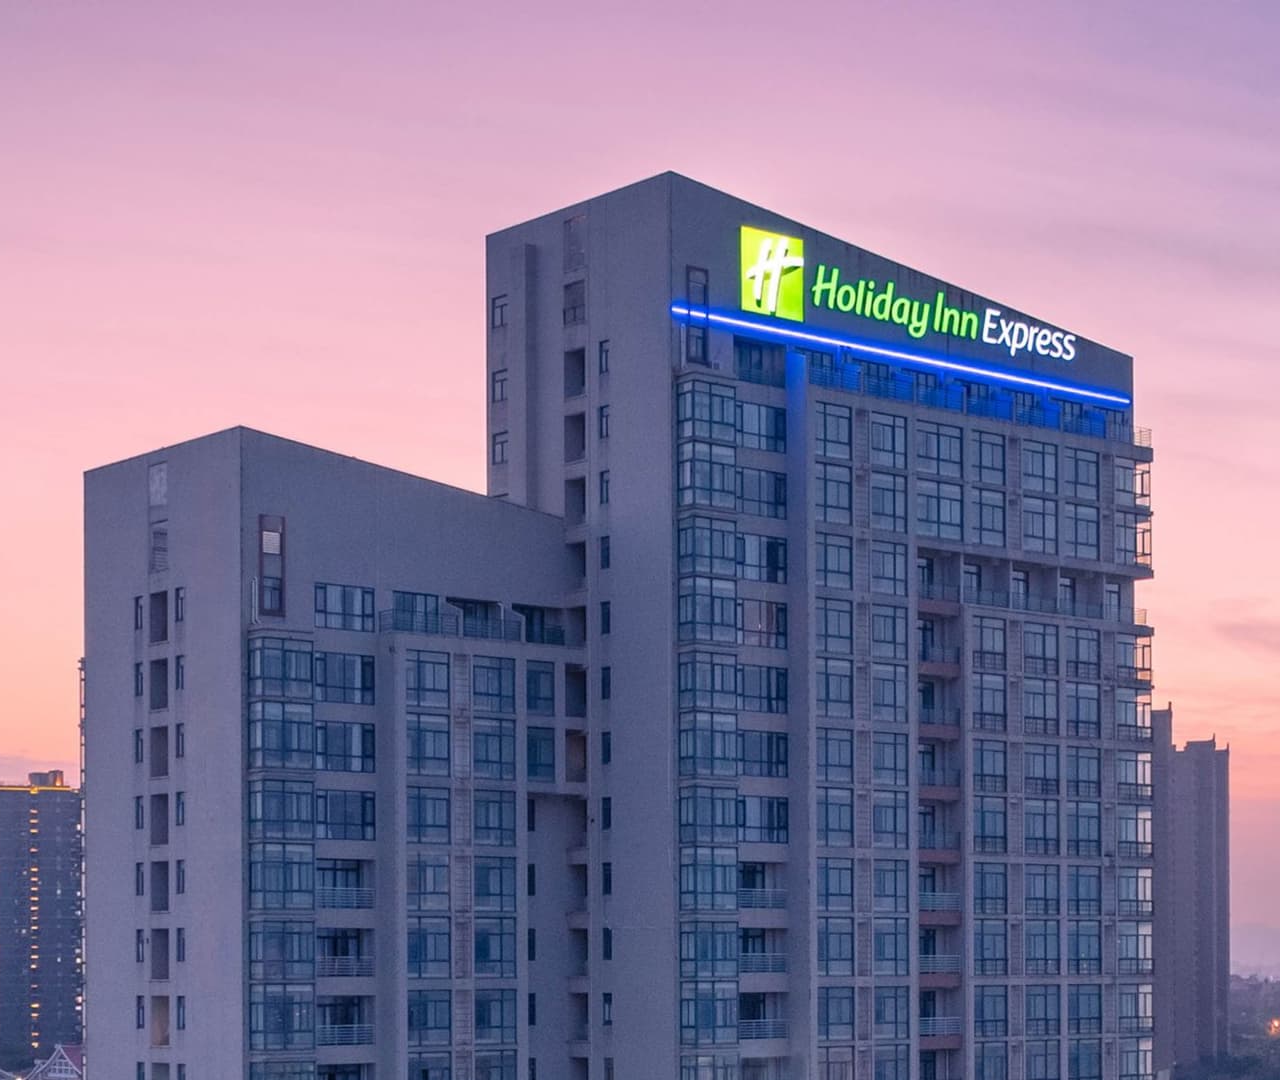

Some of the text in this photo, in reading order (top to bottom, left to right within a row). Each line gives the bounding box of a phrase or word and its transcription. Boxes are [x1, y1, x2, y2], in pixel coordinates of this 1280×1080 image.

[812, 265, 1076, 361] Holiday Inn Express
